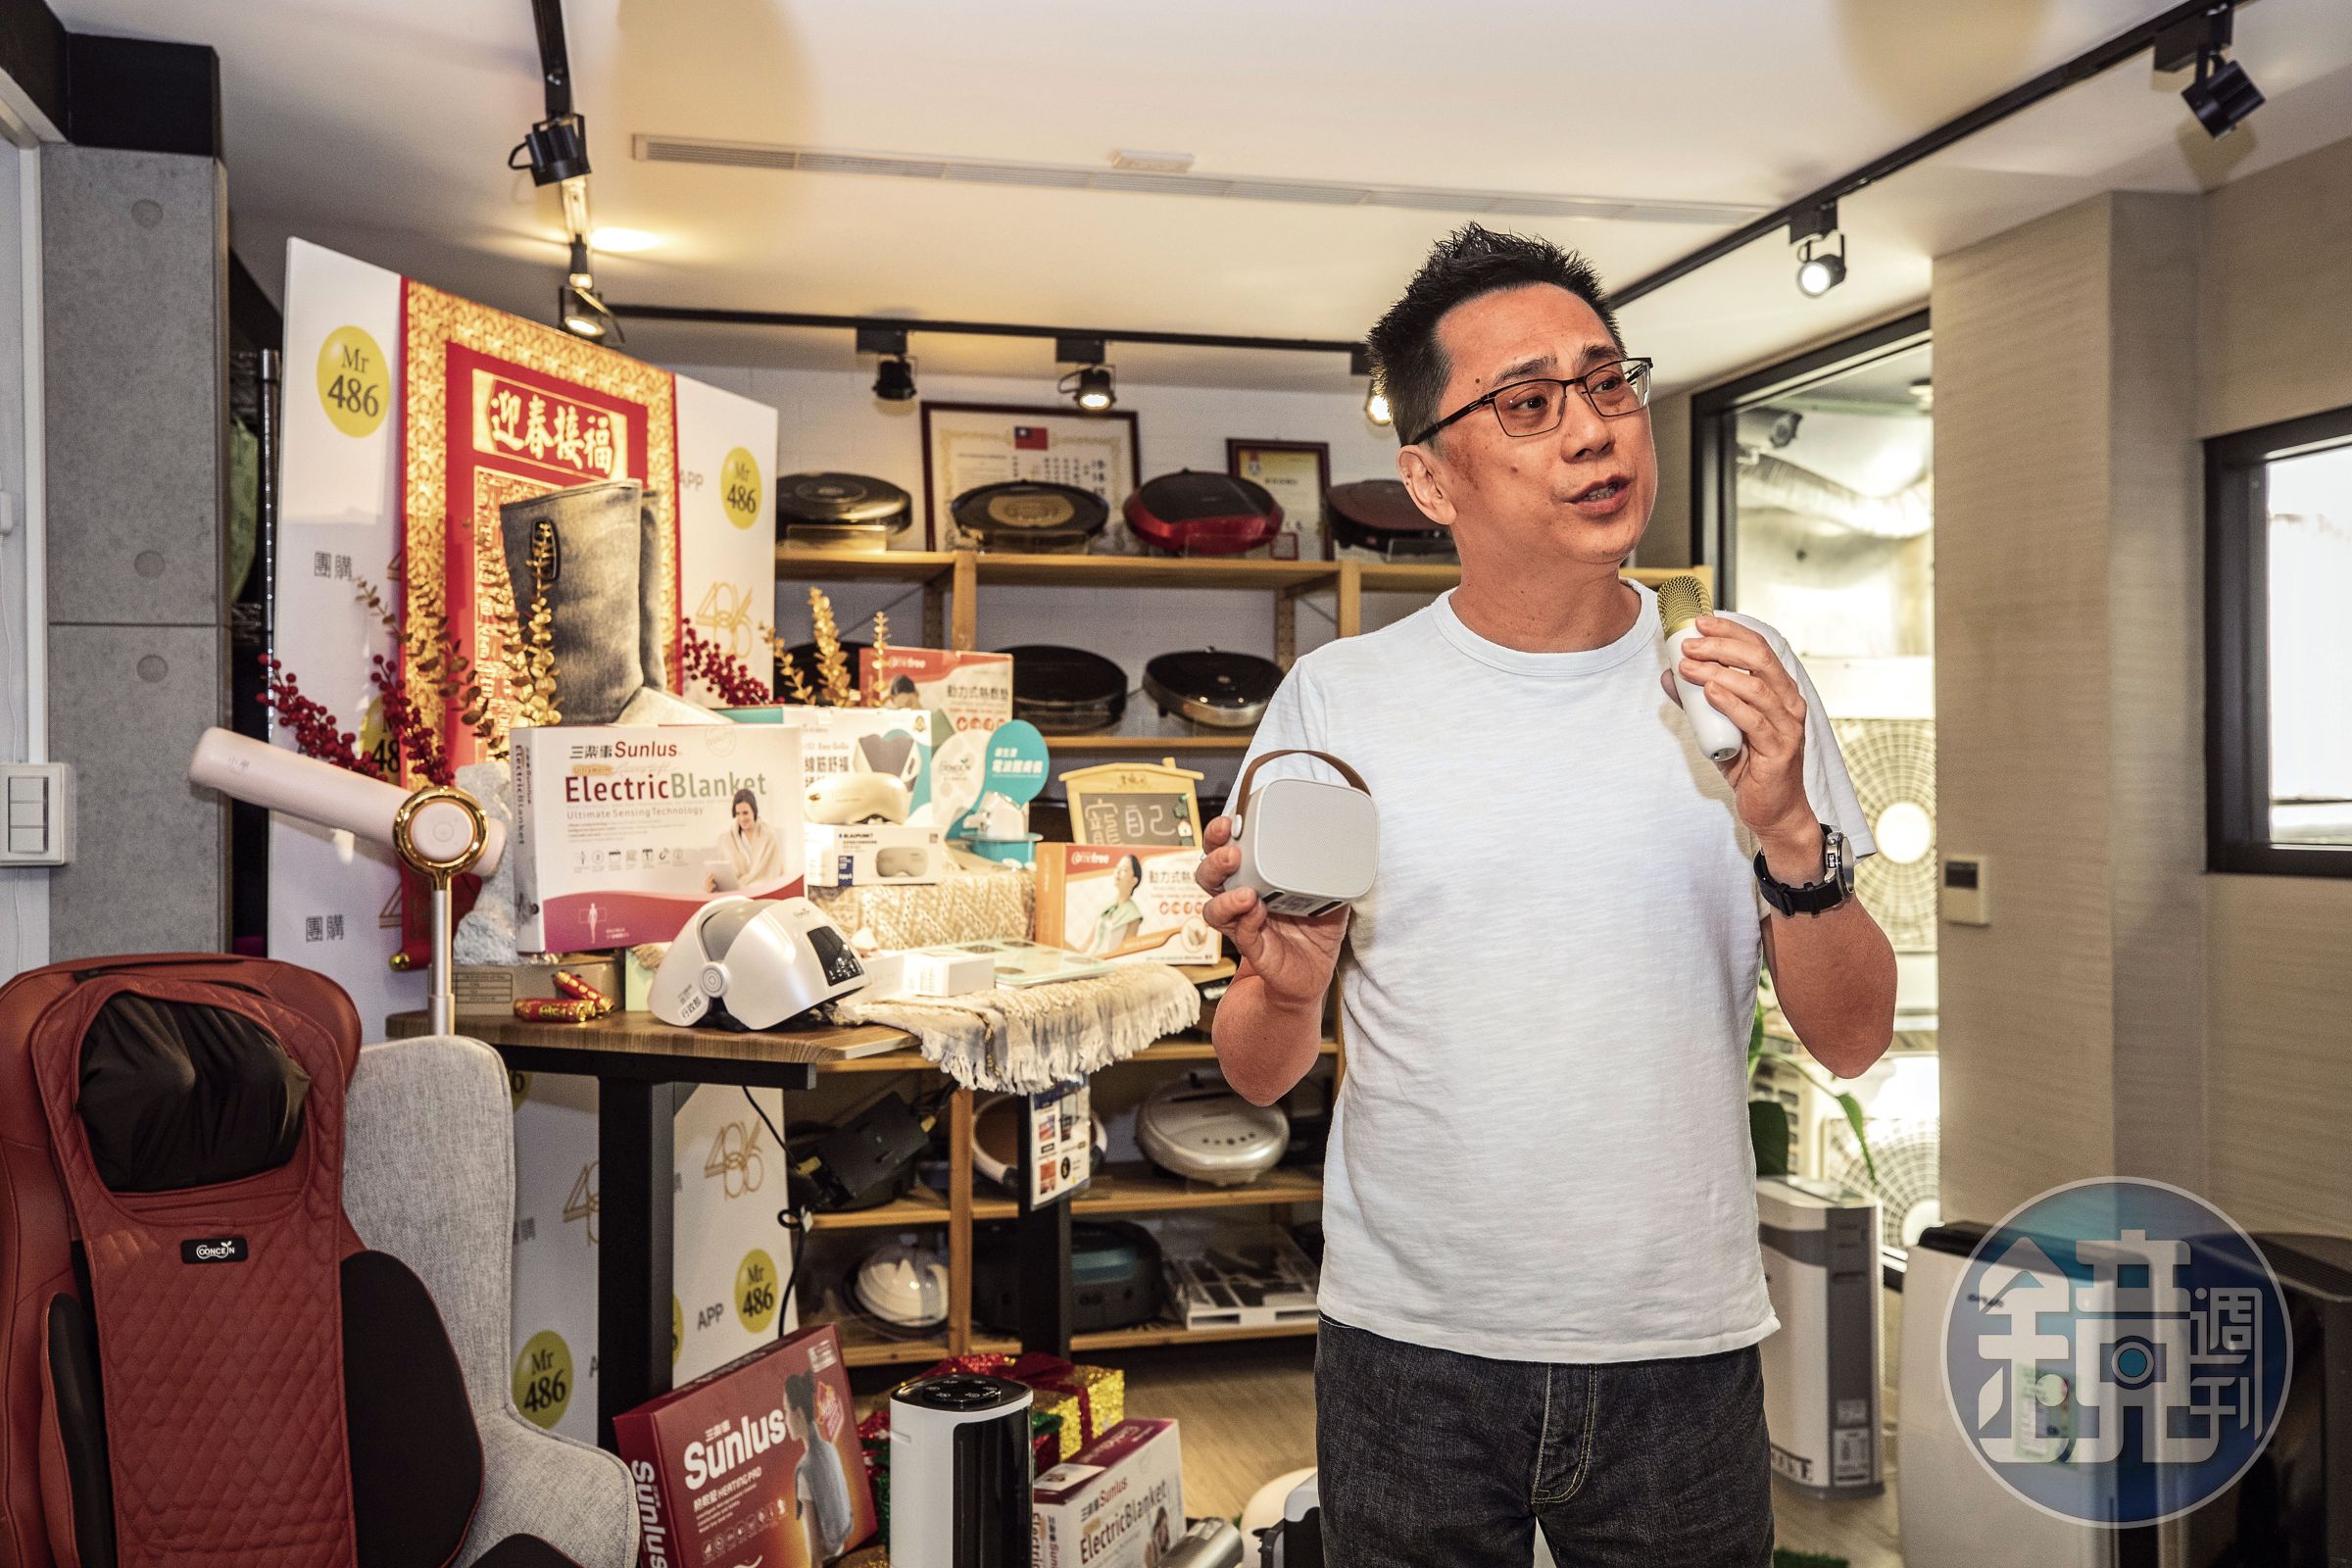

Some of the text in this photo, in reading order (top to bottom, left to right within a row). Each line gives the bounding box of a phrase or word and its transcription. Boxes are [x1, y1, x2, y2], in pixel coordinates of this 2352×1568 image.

[342, 345, 369, 374] Mr
[327, 374, 380, 417] 486
[491, 389, 614, 473] 迎春接福
[735, 463, 750, 482] Mr
[727, 484, 757, 514] 486
[371, 738, 401, 773] 48
[614, 741, 678, 759] Sunlus
[566, 806, 705, 820] Ultimate Sensing Technology
[747, 1265, 764, 1284] Mr
[742, 1283, 774, 1317] 486
[697, 1303, 724, 1332] APP
[531, 1348, 554, 1373] Mr
[523, 1370, 566, 1413] 486
[684, 1408, 787, 1491] Sunlus
[1099, 1477, 1129, 1508] Sunlus
[631, 1459, 668, 1568] Sunlus
